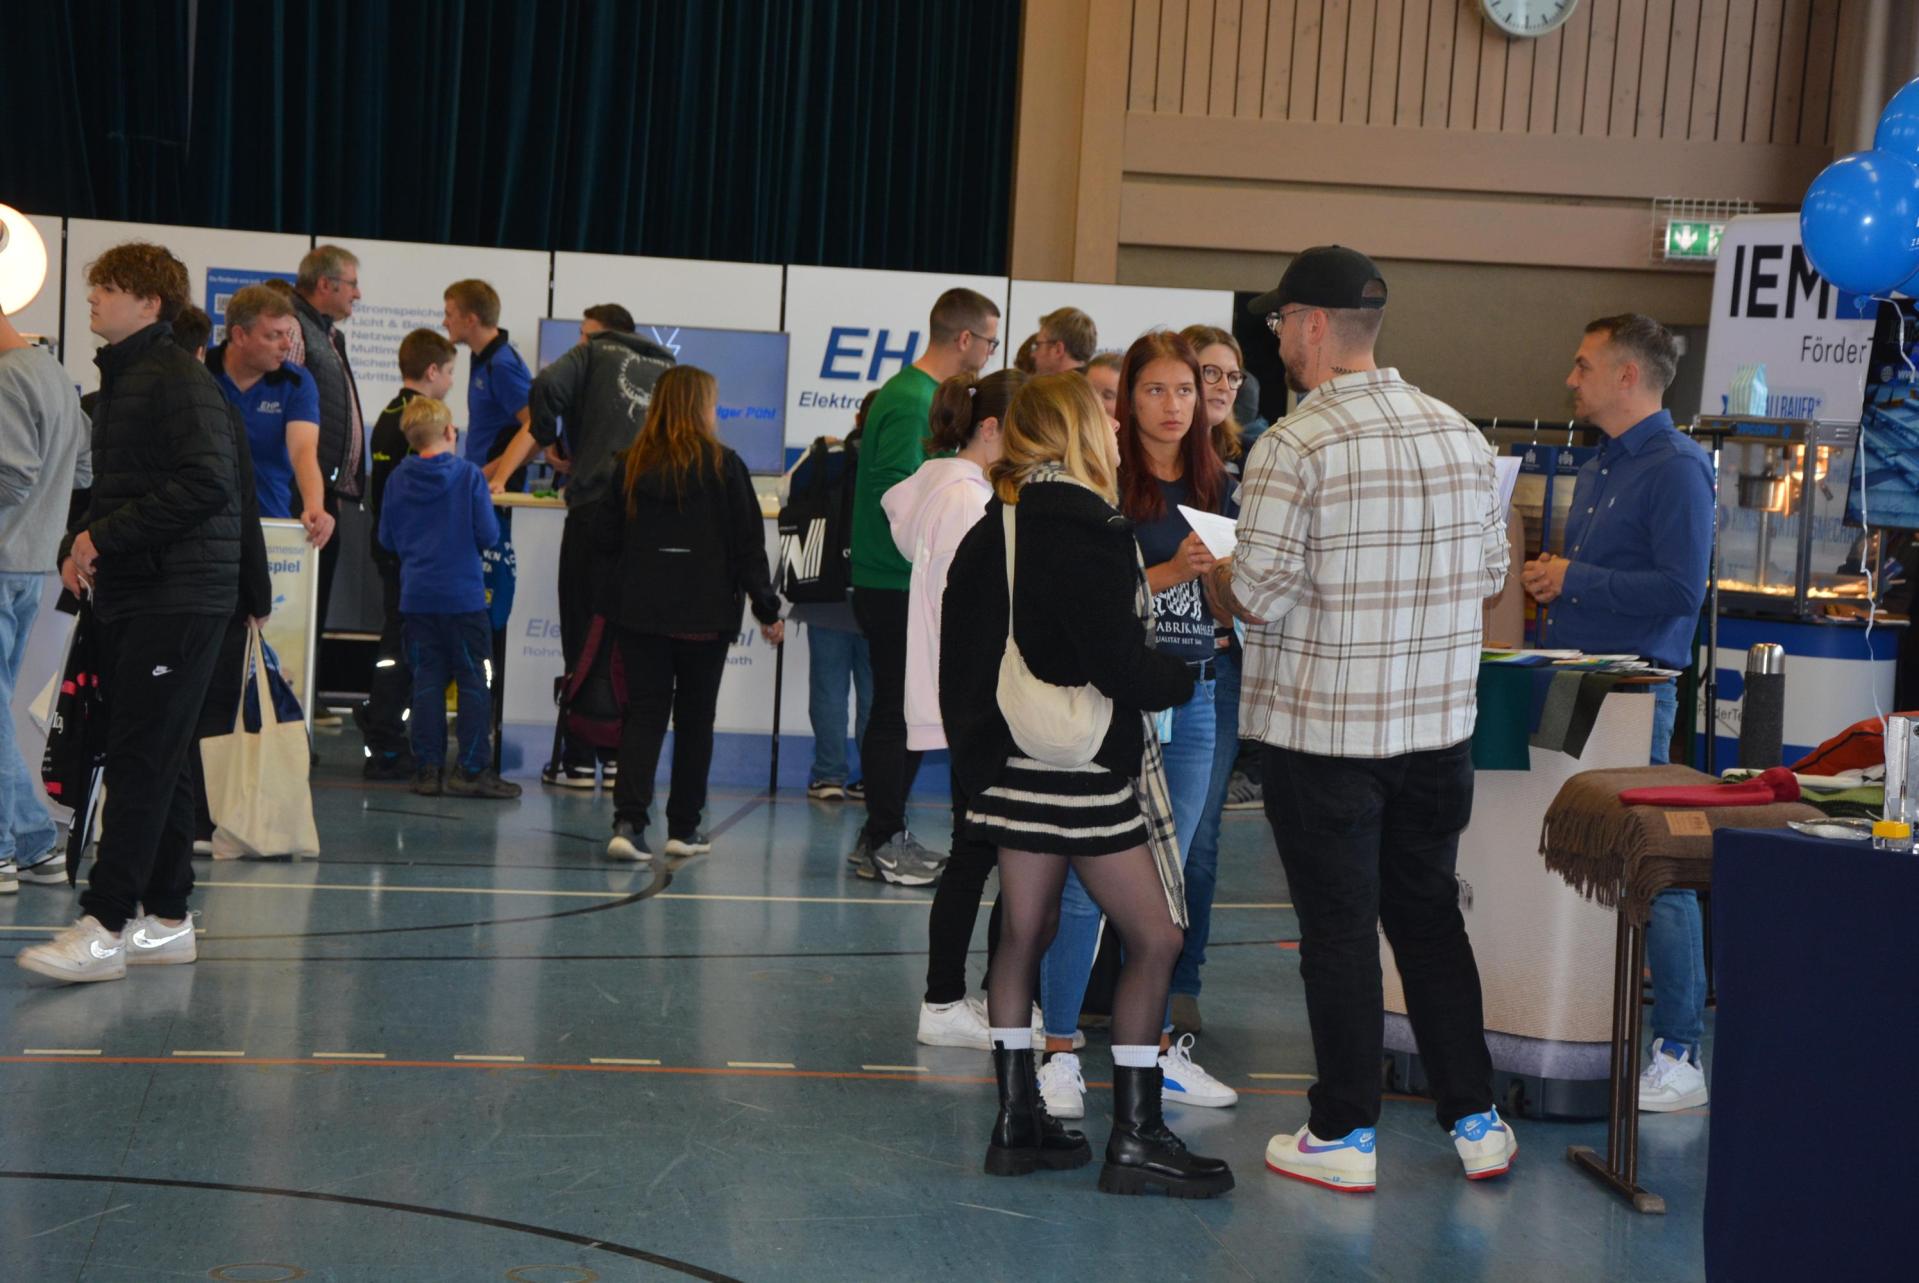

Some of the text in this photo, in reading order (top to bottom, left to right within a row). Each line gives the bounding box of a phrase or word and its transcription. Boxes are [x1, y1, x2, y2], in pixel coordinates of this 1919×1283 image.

[1730, 245, 1830, 319] IEM
[819, 326, 920, 381] EH
[267, 560, 301, 574] spiel
